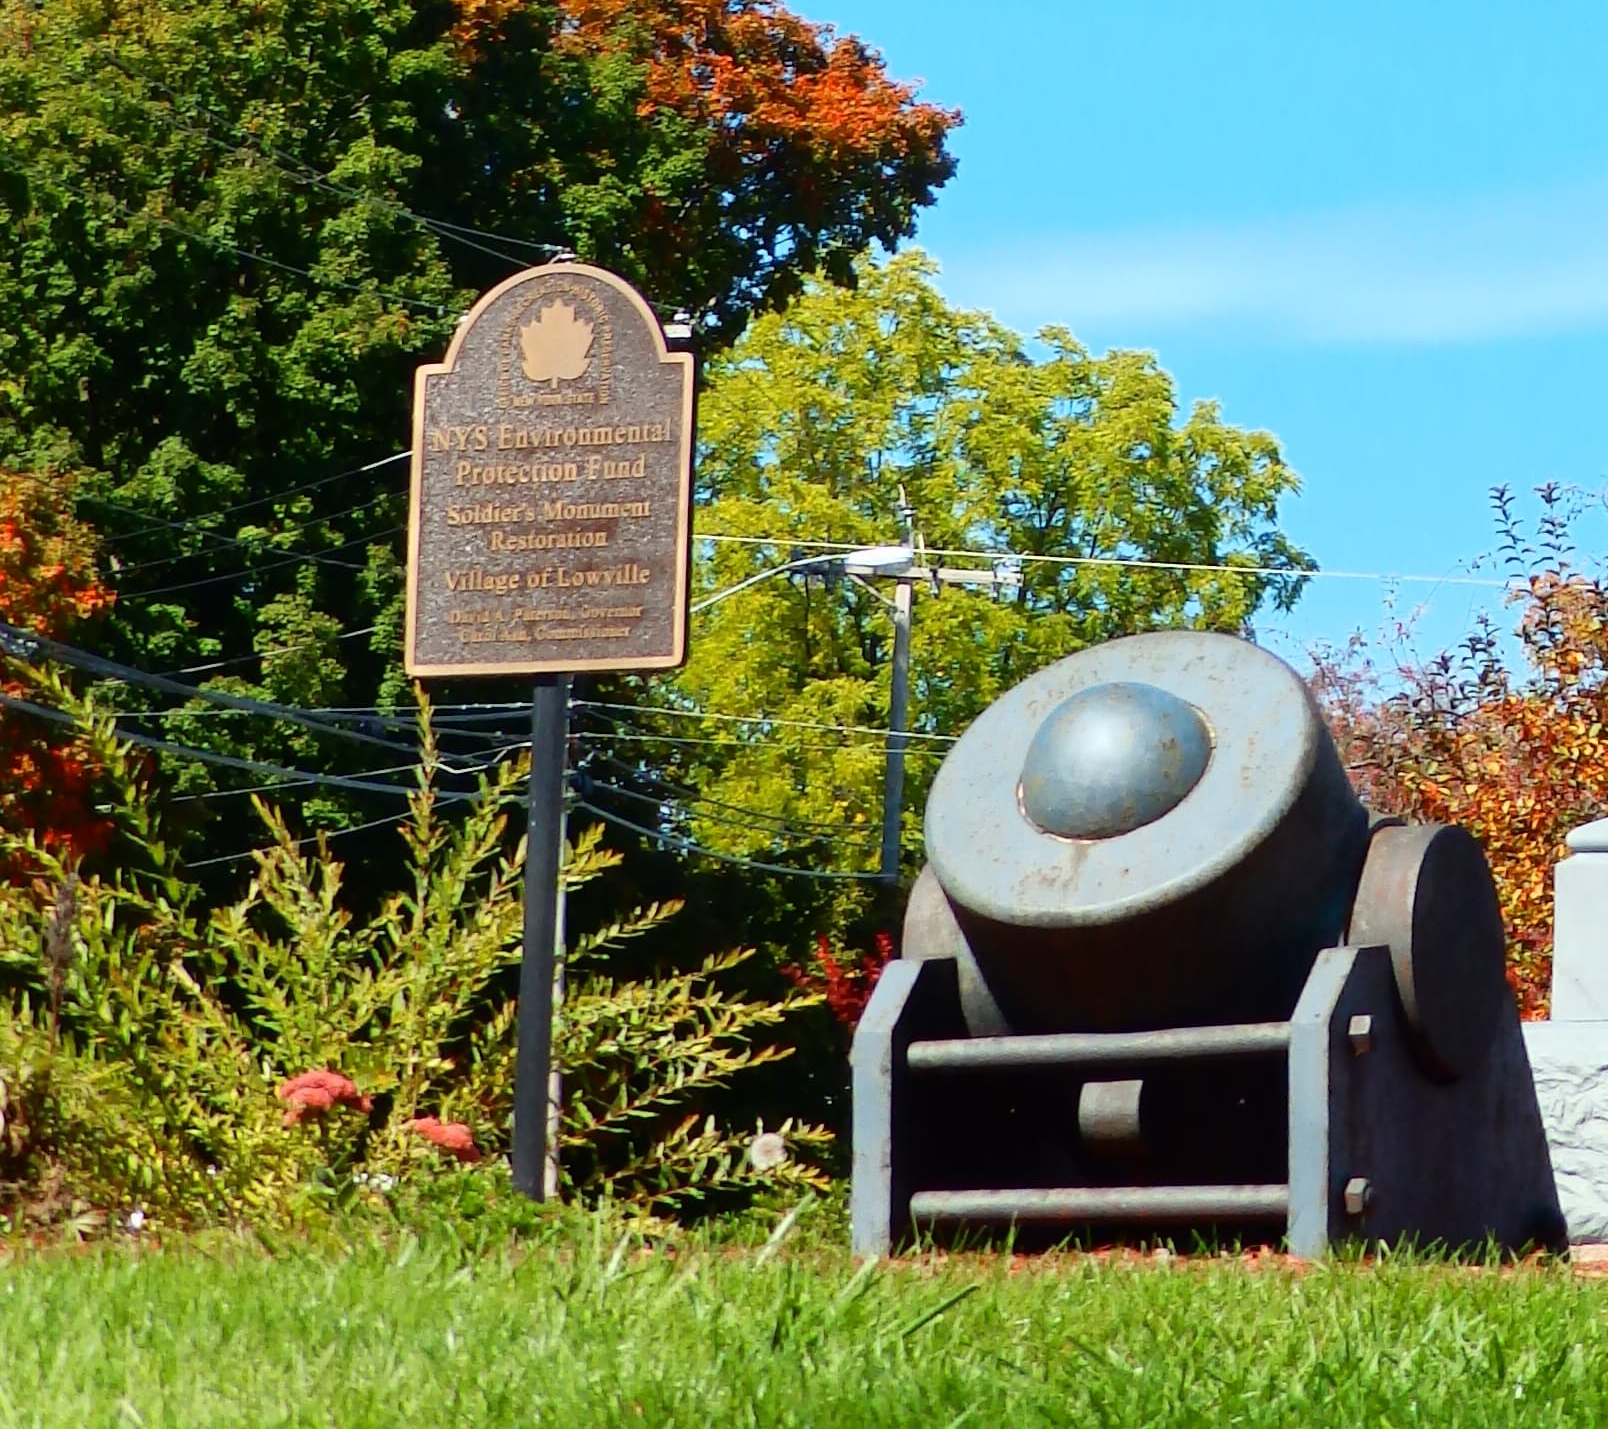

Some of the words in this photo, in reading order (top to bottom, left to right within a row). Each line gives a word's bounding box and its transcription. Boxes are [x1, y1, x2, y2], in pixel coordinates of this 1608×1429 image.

[431, 424, 488, 452] NYS
[498, 417, 673, 450] Environmental
[455, 459, 577, 486] Protection
[586, 453, 646, 480] Fund
[447, 502, 536, 526] Soldier's
[543, 500, 651, 522] Monument
[490, 528, 608, 552] Restoration
[445, 565, 520, 596] Village
[527, 566, 551, 589] of
[556, 563, 651, 588] Lowville
